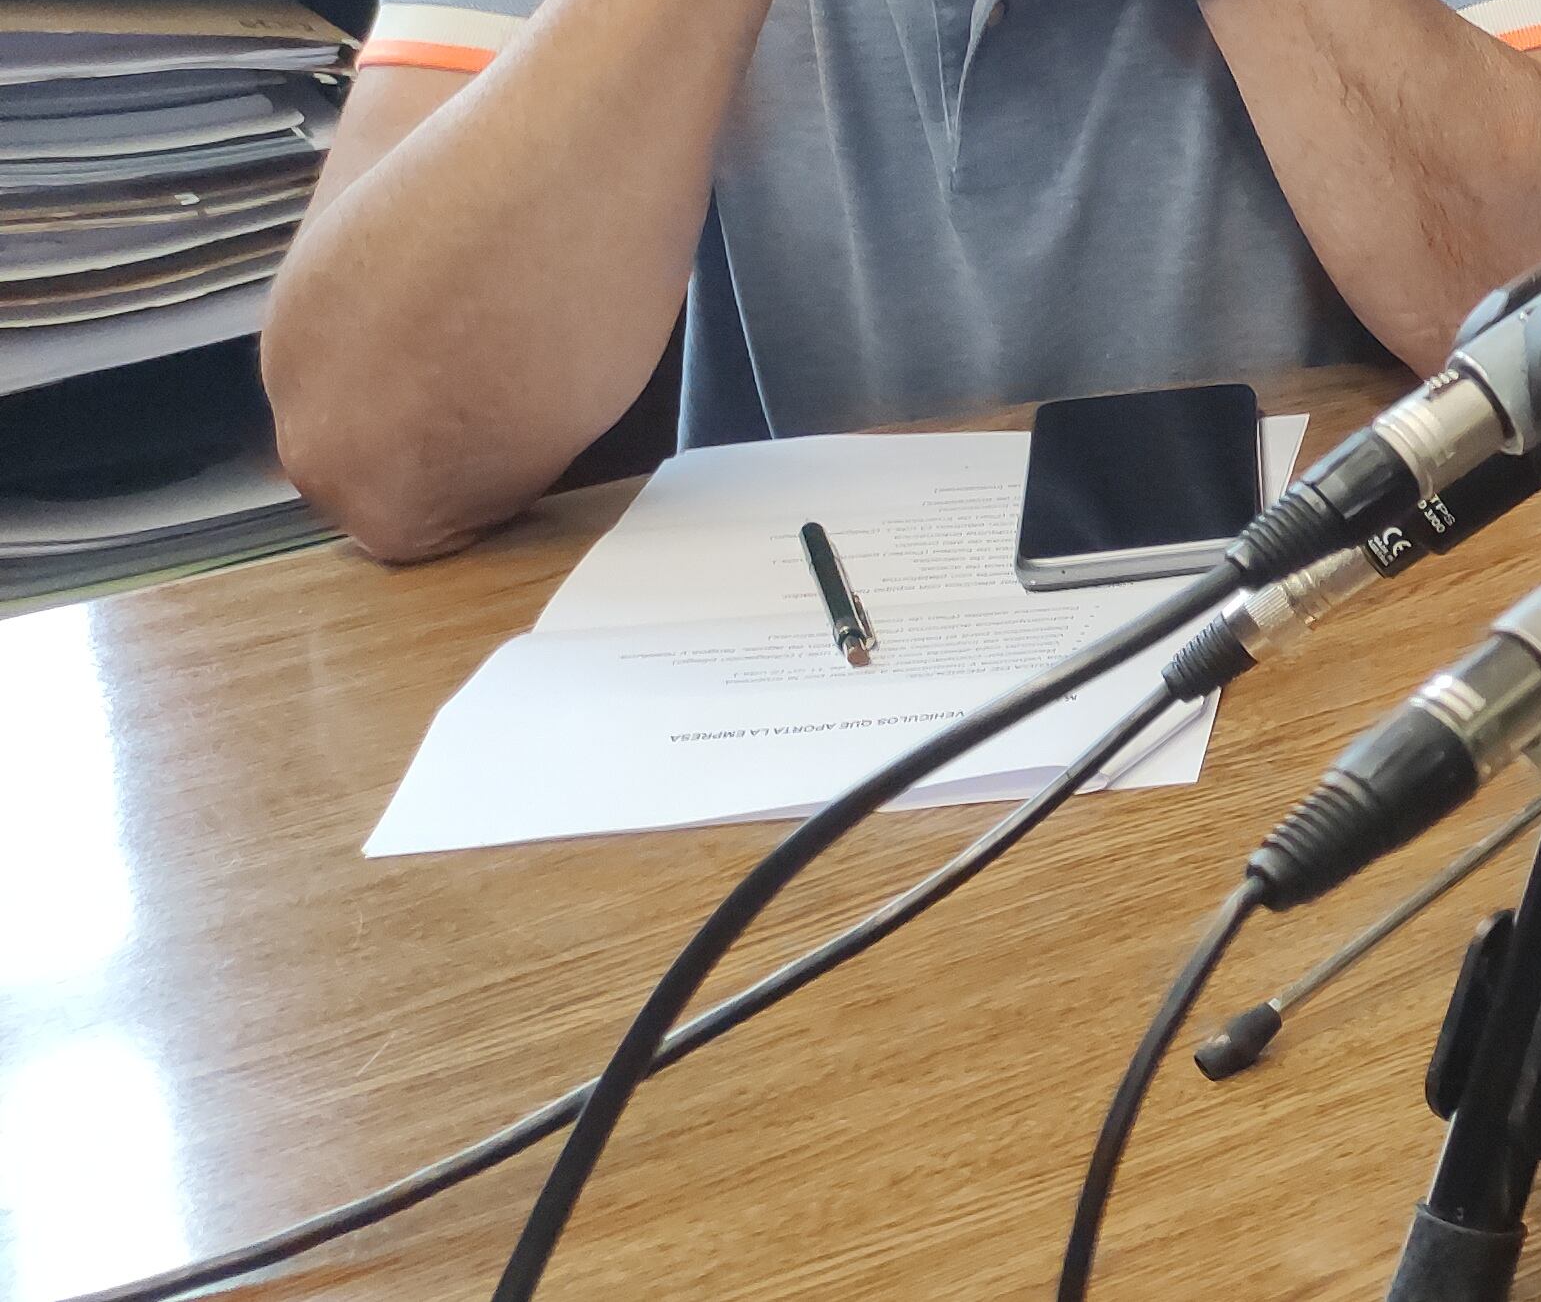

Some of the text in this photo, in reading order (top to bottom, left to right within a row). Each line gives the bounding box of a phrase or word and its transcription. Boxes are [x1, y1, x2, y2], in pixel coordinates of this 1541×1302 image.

[771, 721, 835, 735] APORTA
[839, 717, 873, 728] QUE
[668, 729, 745, 741] EMPRESA
[748, 727, 769, 737] LA
